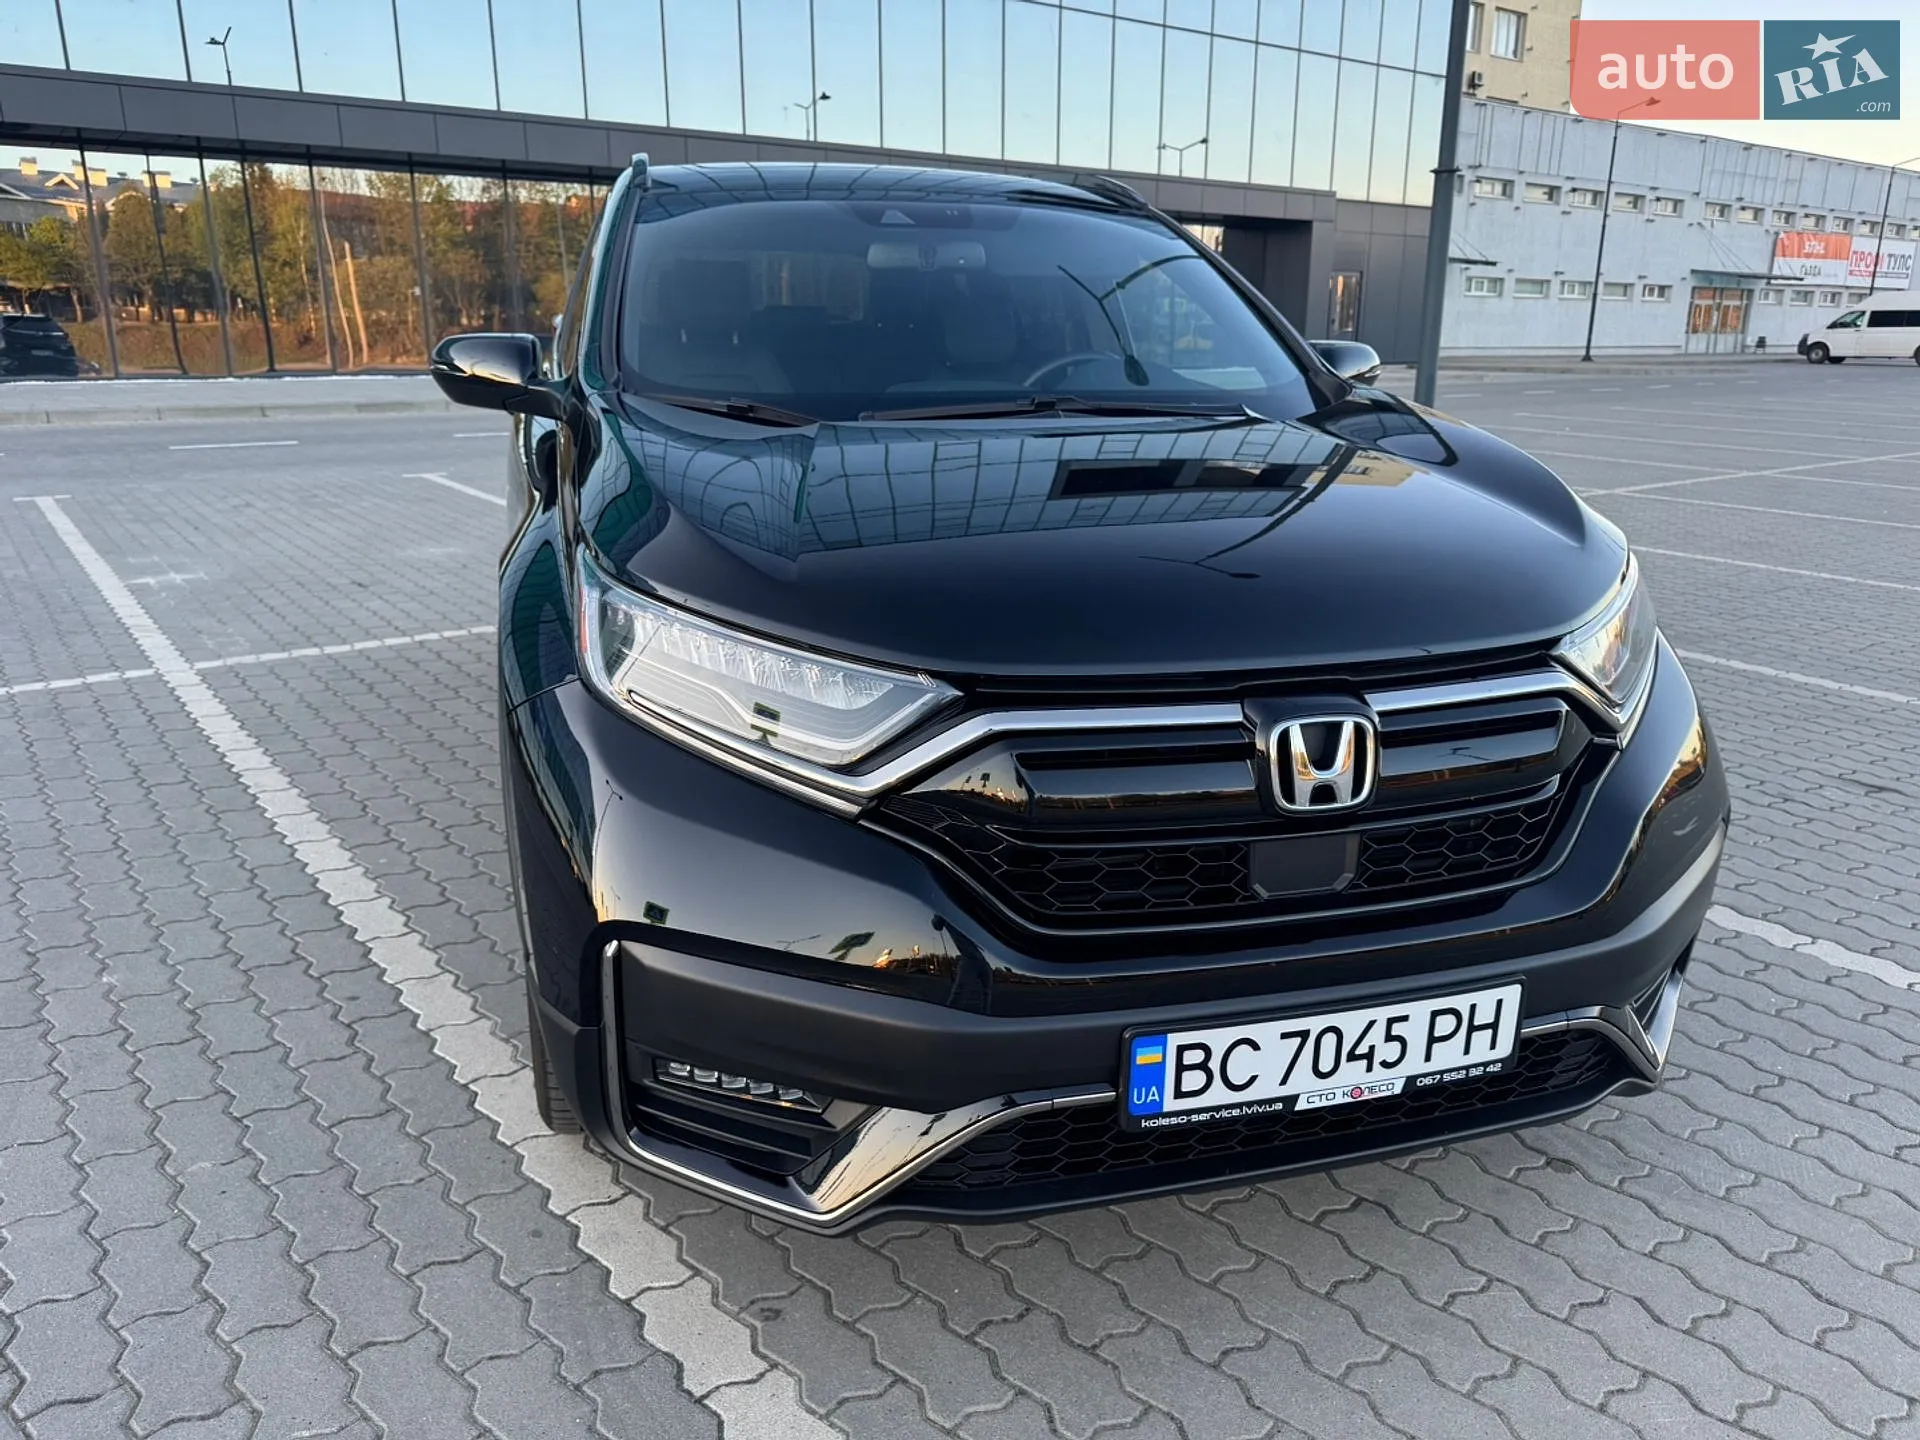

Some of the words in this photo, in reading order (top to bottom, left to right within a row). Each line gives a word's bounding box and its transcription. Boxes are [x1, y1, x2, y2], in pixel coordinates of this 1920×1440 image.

[1173, 1037, 1261, 1100] BC
[1278, 1014, 1410, 1087] 7045
[1424, 998, 1503, 1063] PH
[1416, 1074, 1441, 1087] 067
[1133, 1086, 1160, 1104] UA
[1141, 1101, 1283, 1129] koleso-service.lviv.ua
